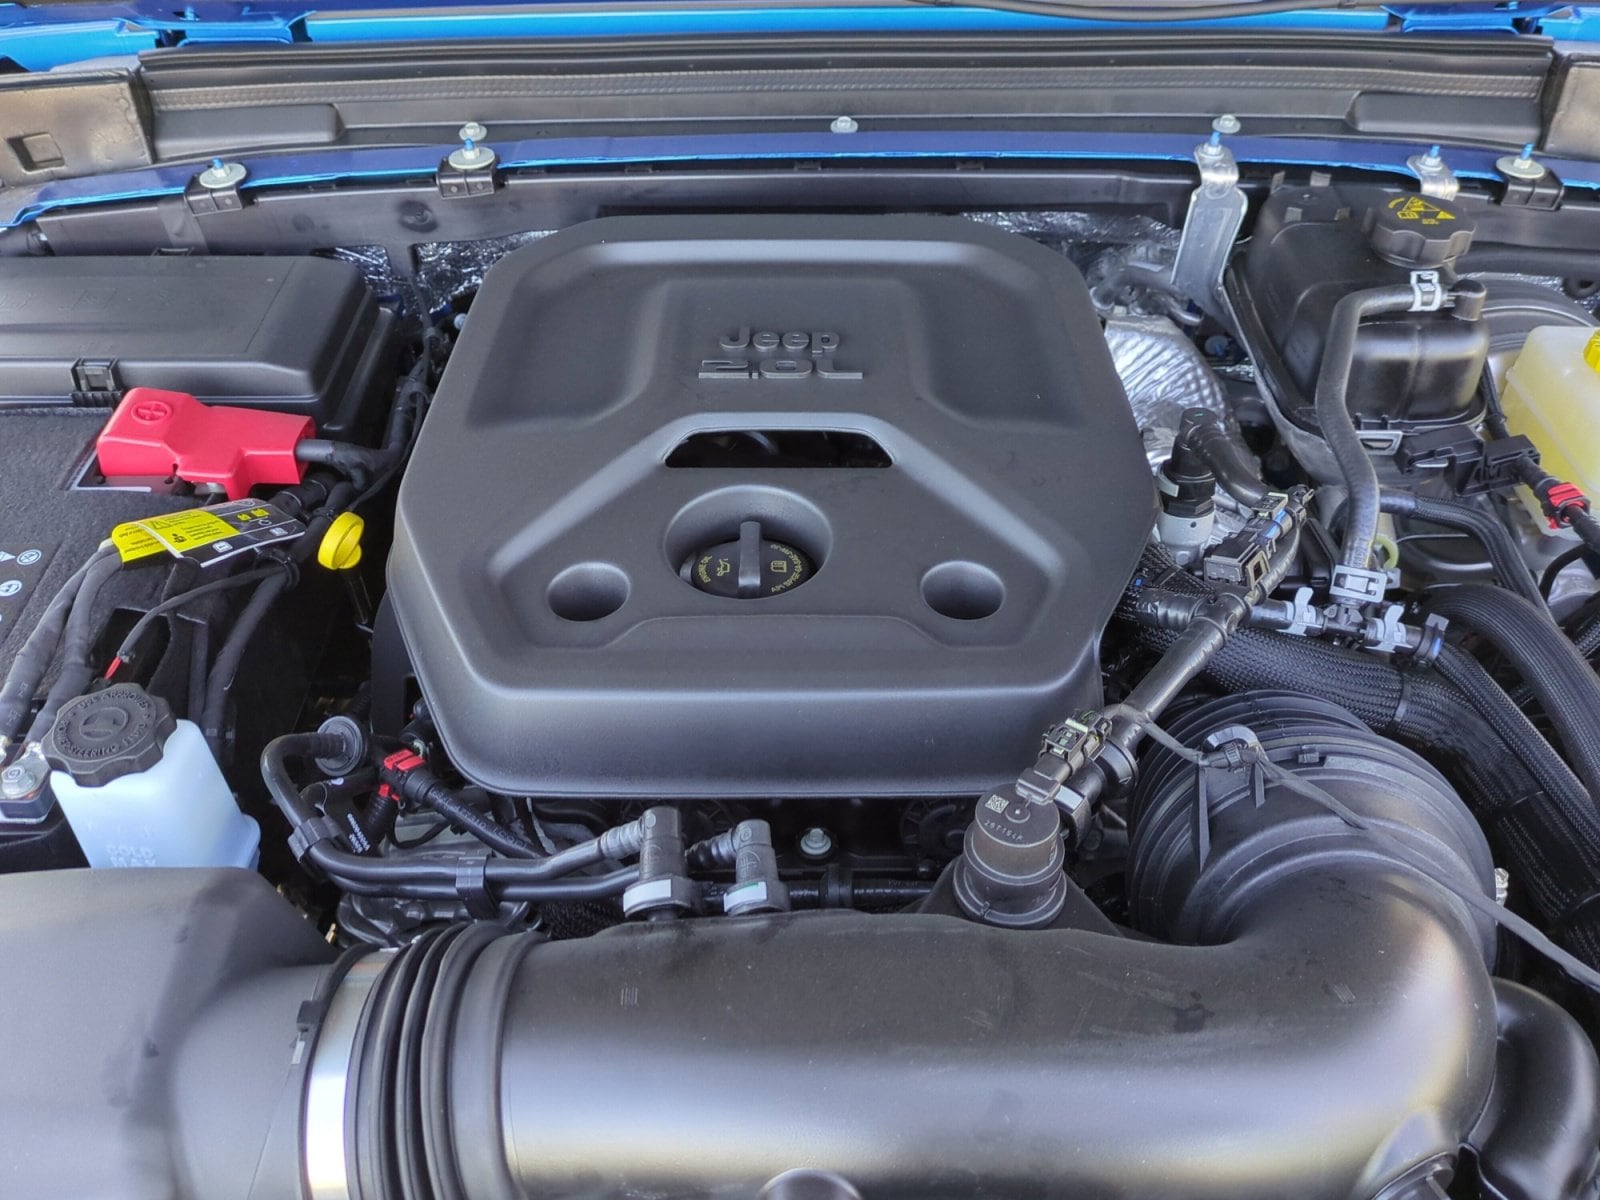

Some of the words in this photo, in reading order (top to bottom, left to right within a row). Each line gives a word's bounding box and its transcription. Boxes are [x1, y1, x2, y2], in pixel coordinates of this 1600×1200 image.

[719, 326, 840, 357] Jeep
[698, 359, 864, 379] 2.0L
[101, 690, 150, 709] APPROVED
[122, 723, 147, 746] FLUID
[105, 844, 154, 859] COLD
